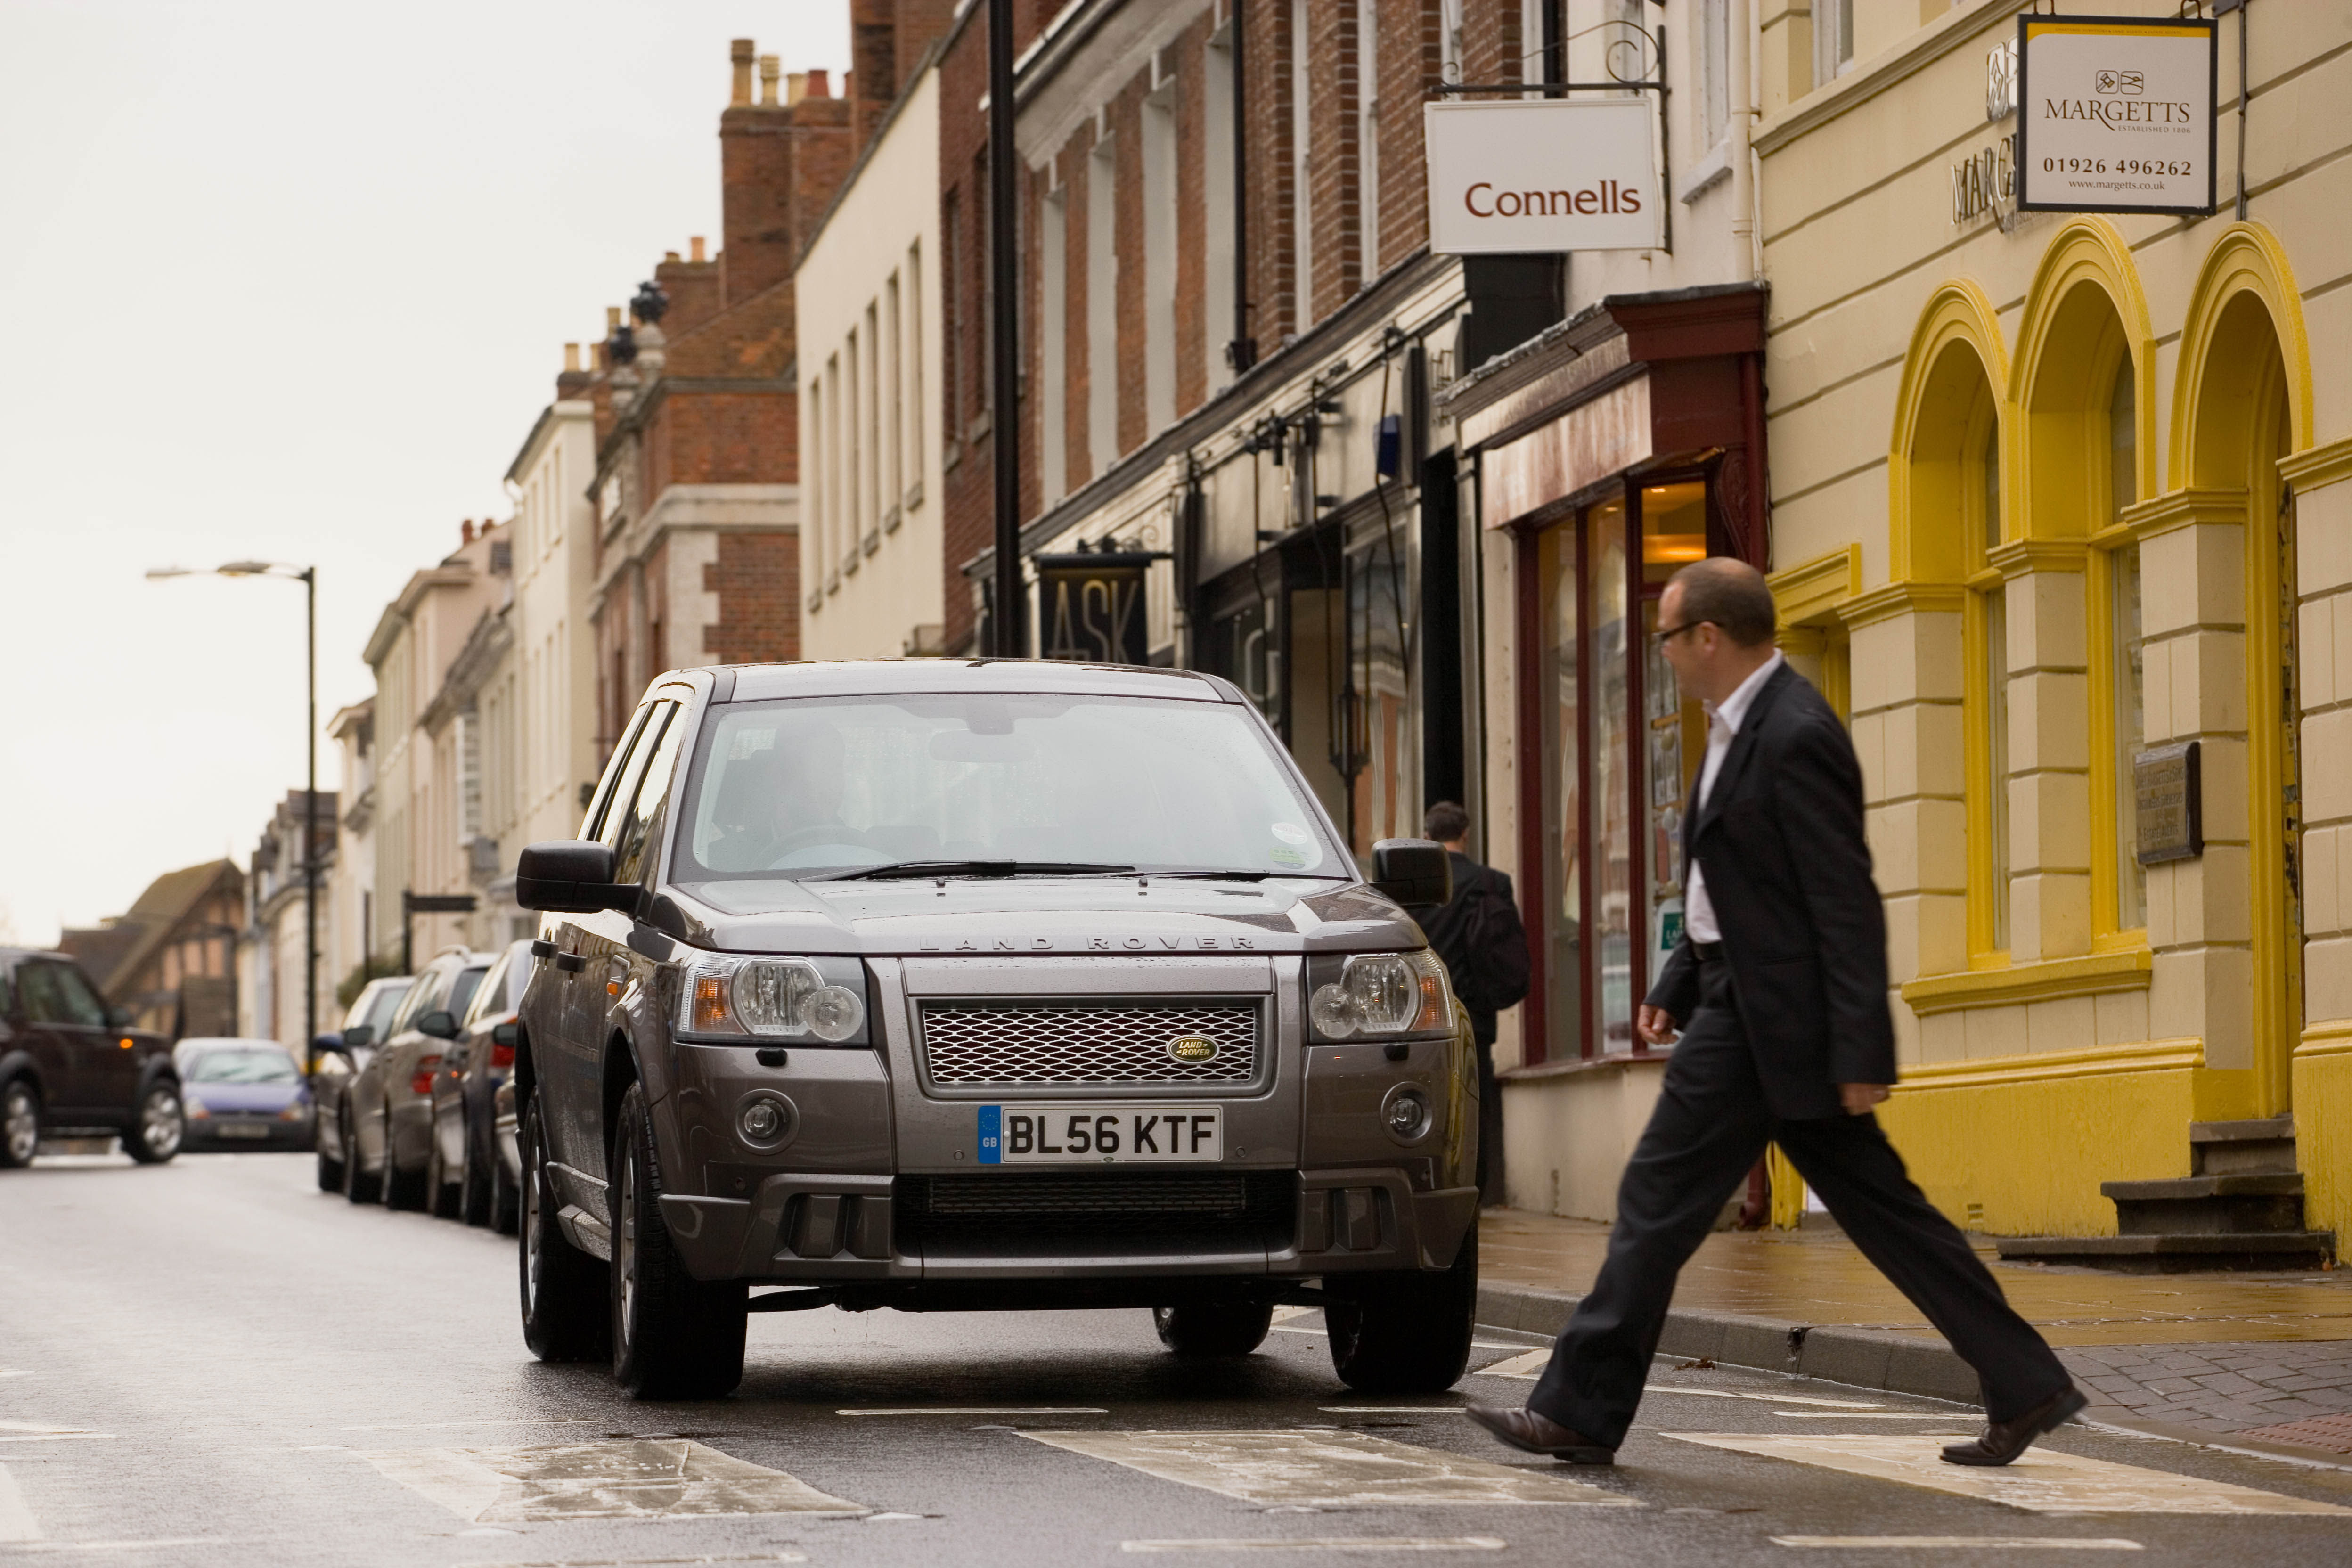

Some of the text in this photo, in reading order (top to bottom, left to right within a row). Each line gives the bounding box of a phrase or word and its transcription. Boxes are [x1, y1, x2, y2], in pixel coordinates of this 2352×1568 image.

[2044, 99, 2190, 131] MARGETTS
[2043, 158, 2191, 176] 01926 496262
[1465, 180, 1641, 217] Connells
[2069, 181, 2164, 191] www.margetts.co.uk
[1047, 580, 1139, 663] ASK
[920, 937, 1254, 950] LAND ROVER
[983, 1137, 997, 1147] GB
[1009, 1116, 1215, 1154] BL56 KTF
